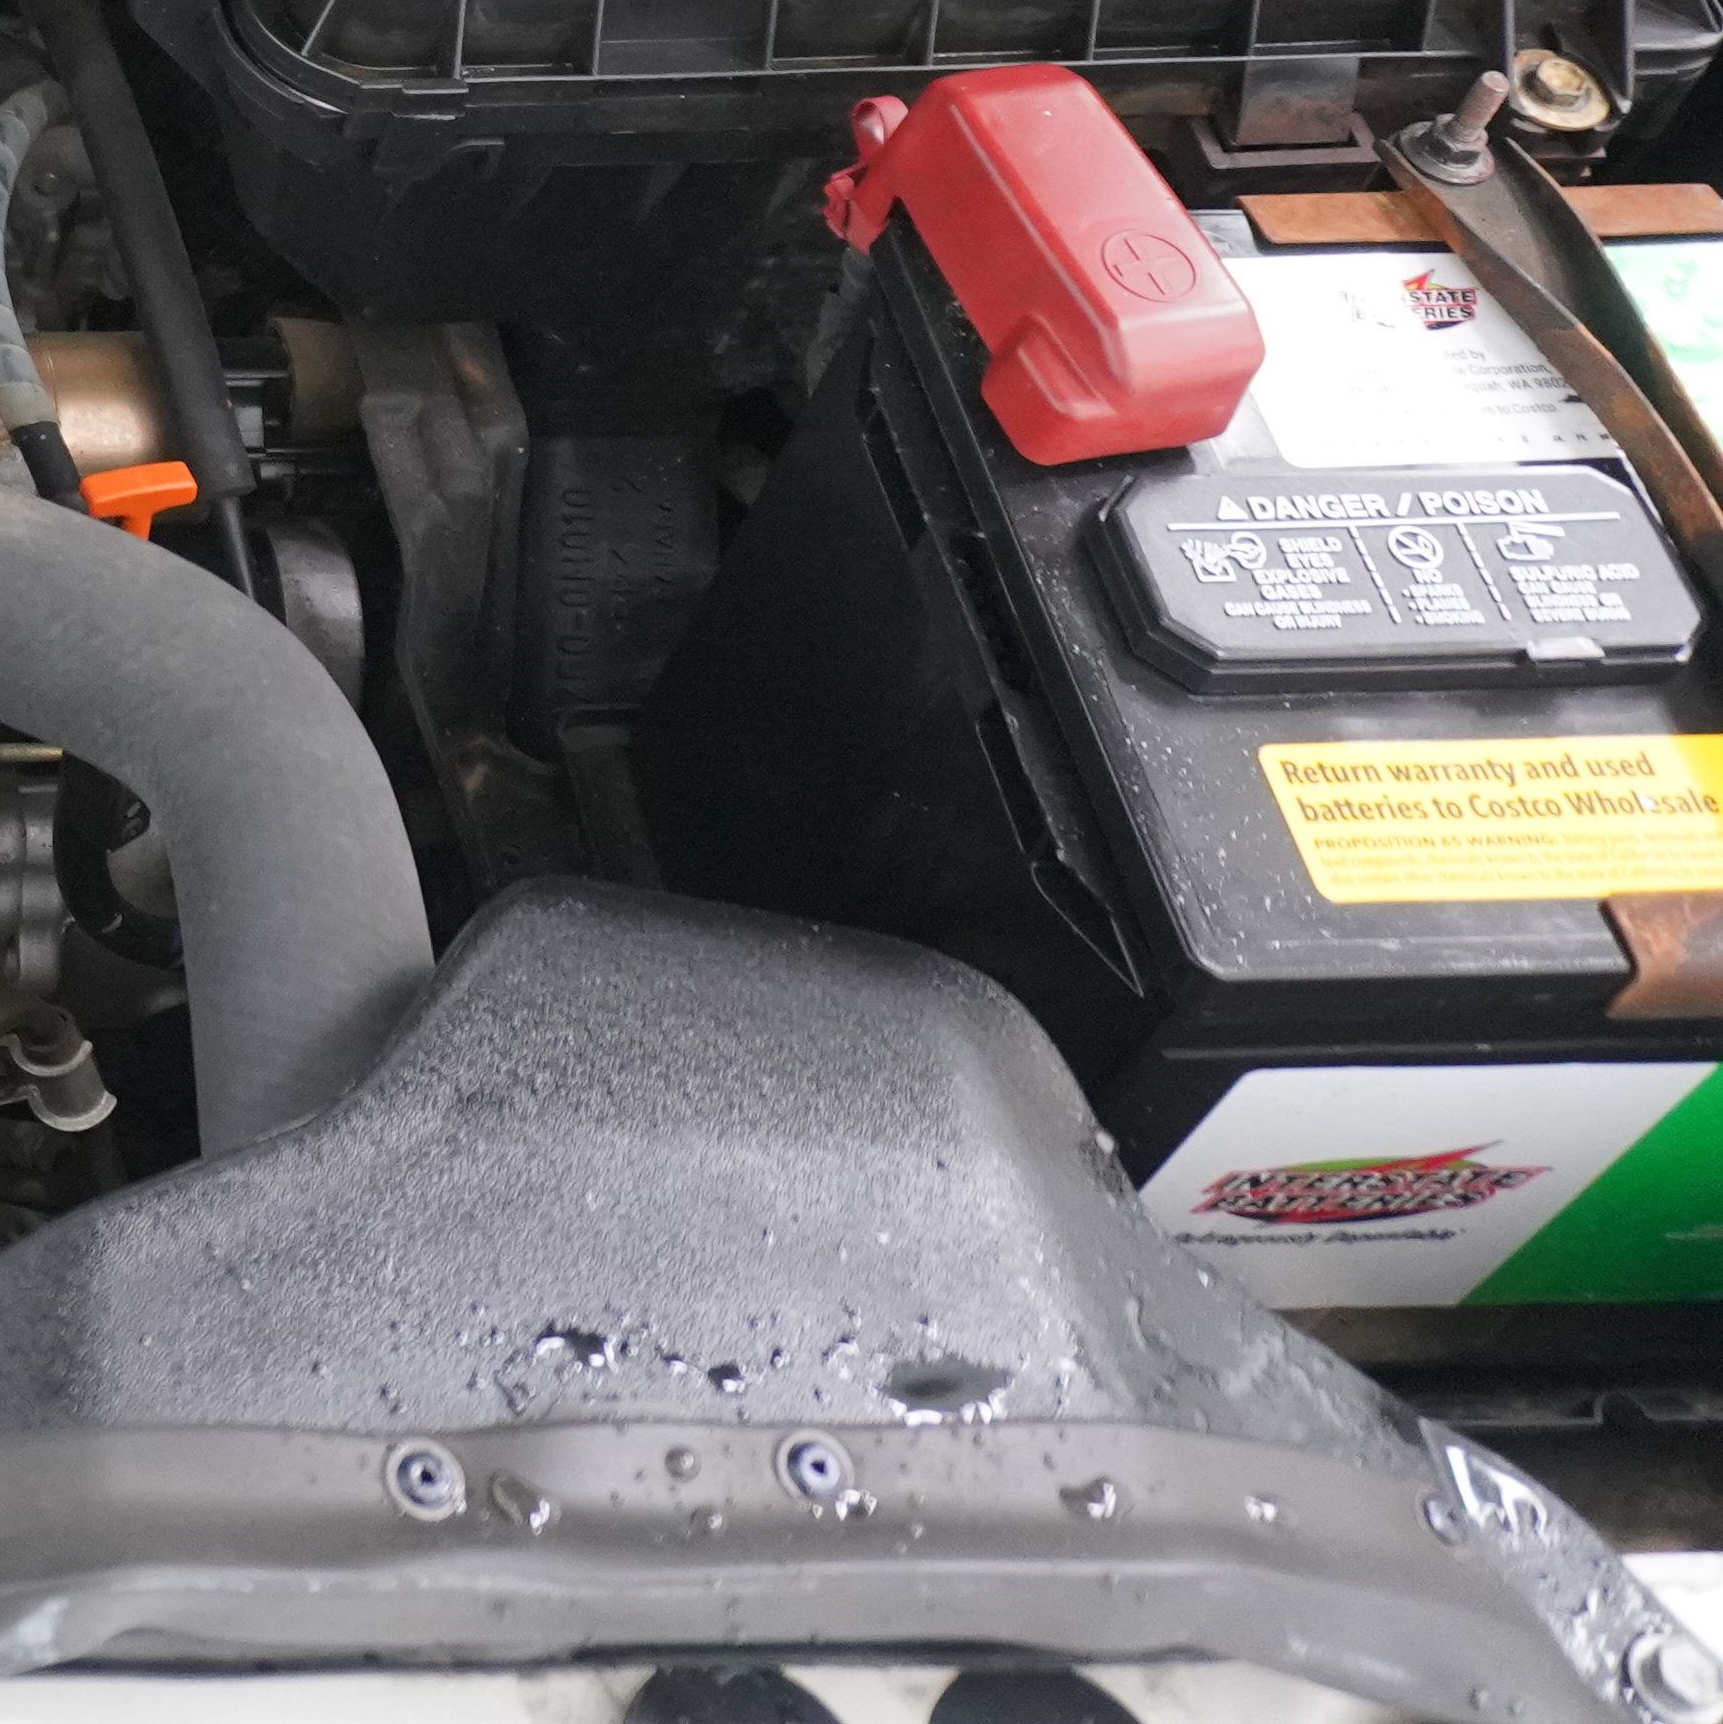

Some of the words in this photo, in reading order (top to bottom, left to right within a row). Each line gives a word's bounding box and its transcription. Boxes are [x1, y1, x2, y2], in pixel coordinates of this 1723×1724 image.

[1246, 492, 1391, 520] DANGER
[1396, 492, 1413, 518] /
[1417, 488, 1550, 516] POISON
[1280, 759, 1383, 785] Return
[1386, 760, 1517, 788] warranty
[1523, 753, 1580, 780] and
[1585, 751, 1655, 779] used
[1297, 793, 1427, 823] batteries
[1432, 798, 1463, 820] to
[1468, 793, 1563, 820] Costco
[1563, 787, 1721, 816] Wholesale
